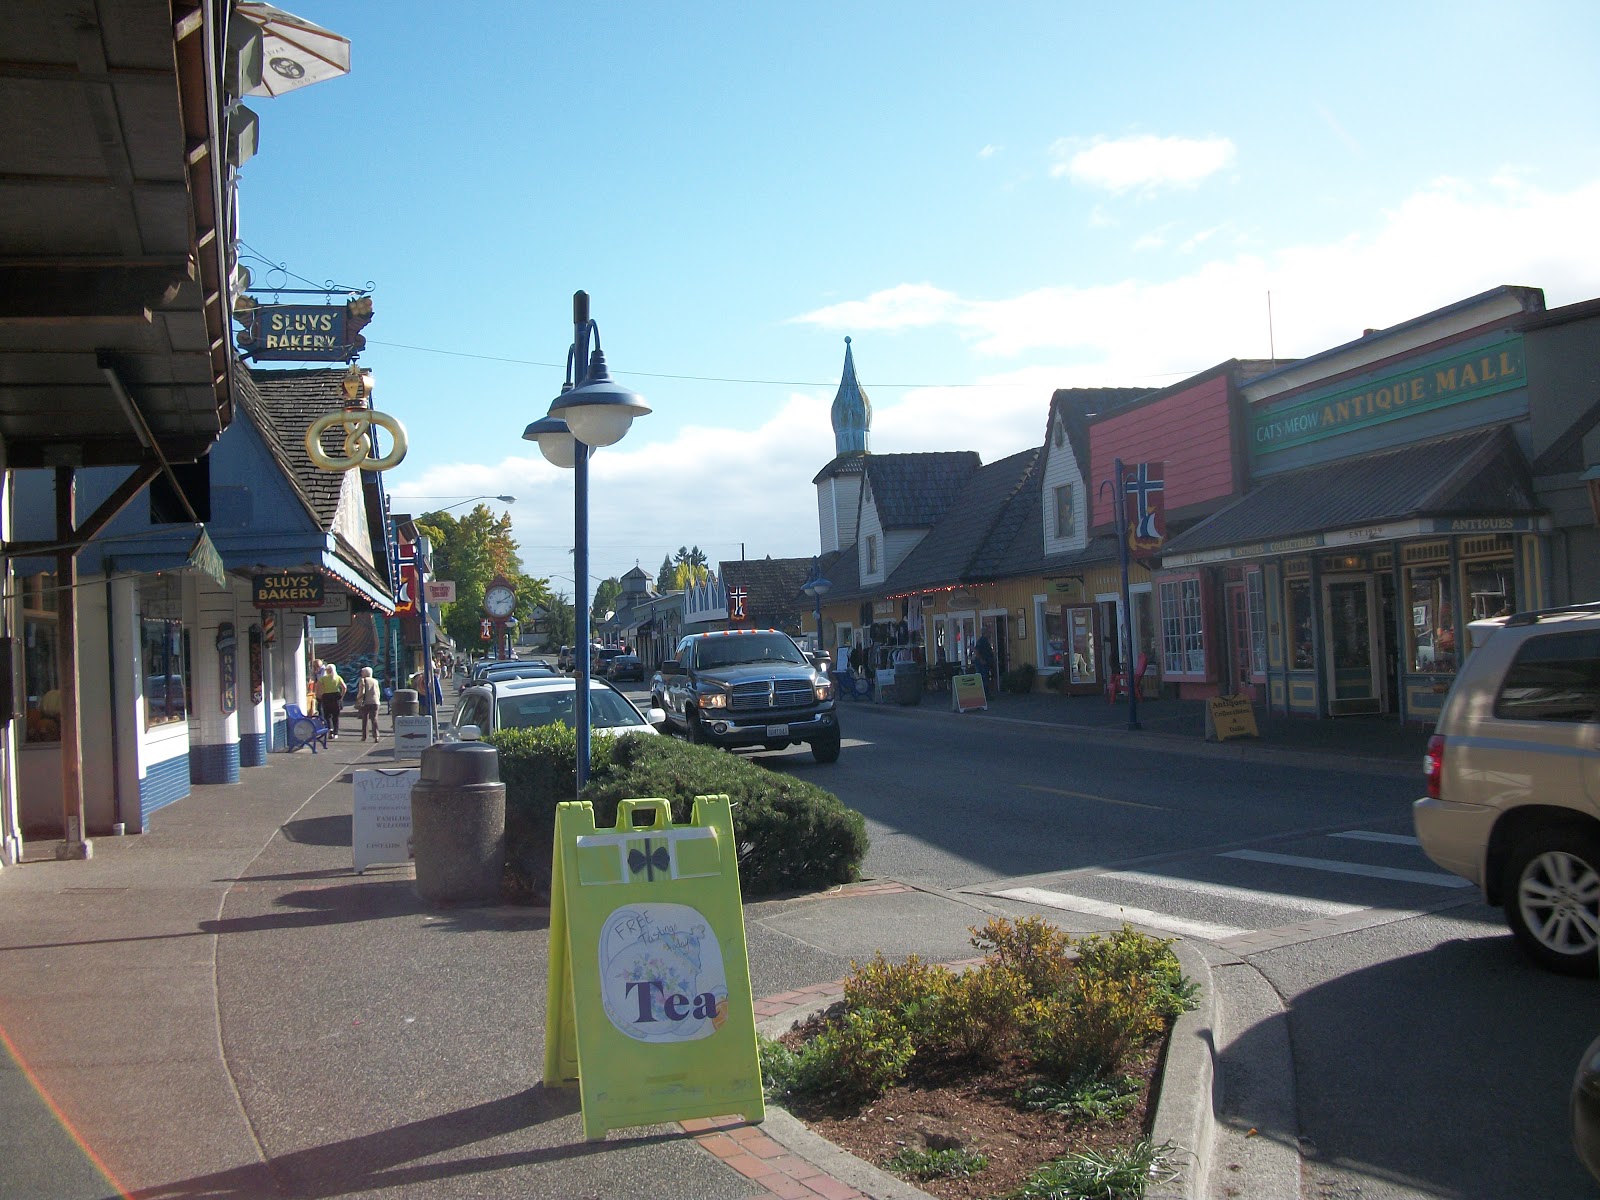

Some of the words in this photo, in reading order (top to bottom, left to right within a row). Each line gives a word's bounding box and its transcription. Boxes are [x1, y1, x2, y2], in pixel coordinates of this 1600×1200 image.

[271, 312, 338, 331] SLUYS'
[266, 334, 336, 351] BAKERY
[1256, 421, 1282, 442] CAT'S
[1284, 411, 1319, 434] MEOW
[1322, 378, 1425, 426] ANTIQUE
[1435, 352, 1516, 393] MALL
[1452, 518, 1513, 530] ANTIQUES
[1270, 537, 1317, 552] COLLECTIBLES
[264, 576, 314, 588] SLUYS'
[258, 588, 319, 601] BAKERY
[223, 655, 234, 708] BAKERY
[614, 910, 654, 940] FREE
[625, 980, 720, 1024] Tea
